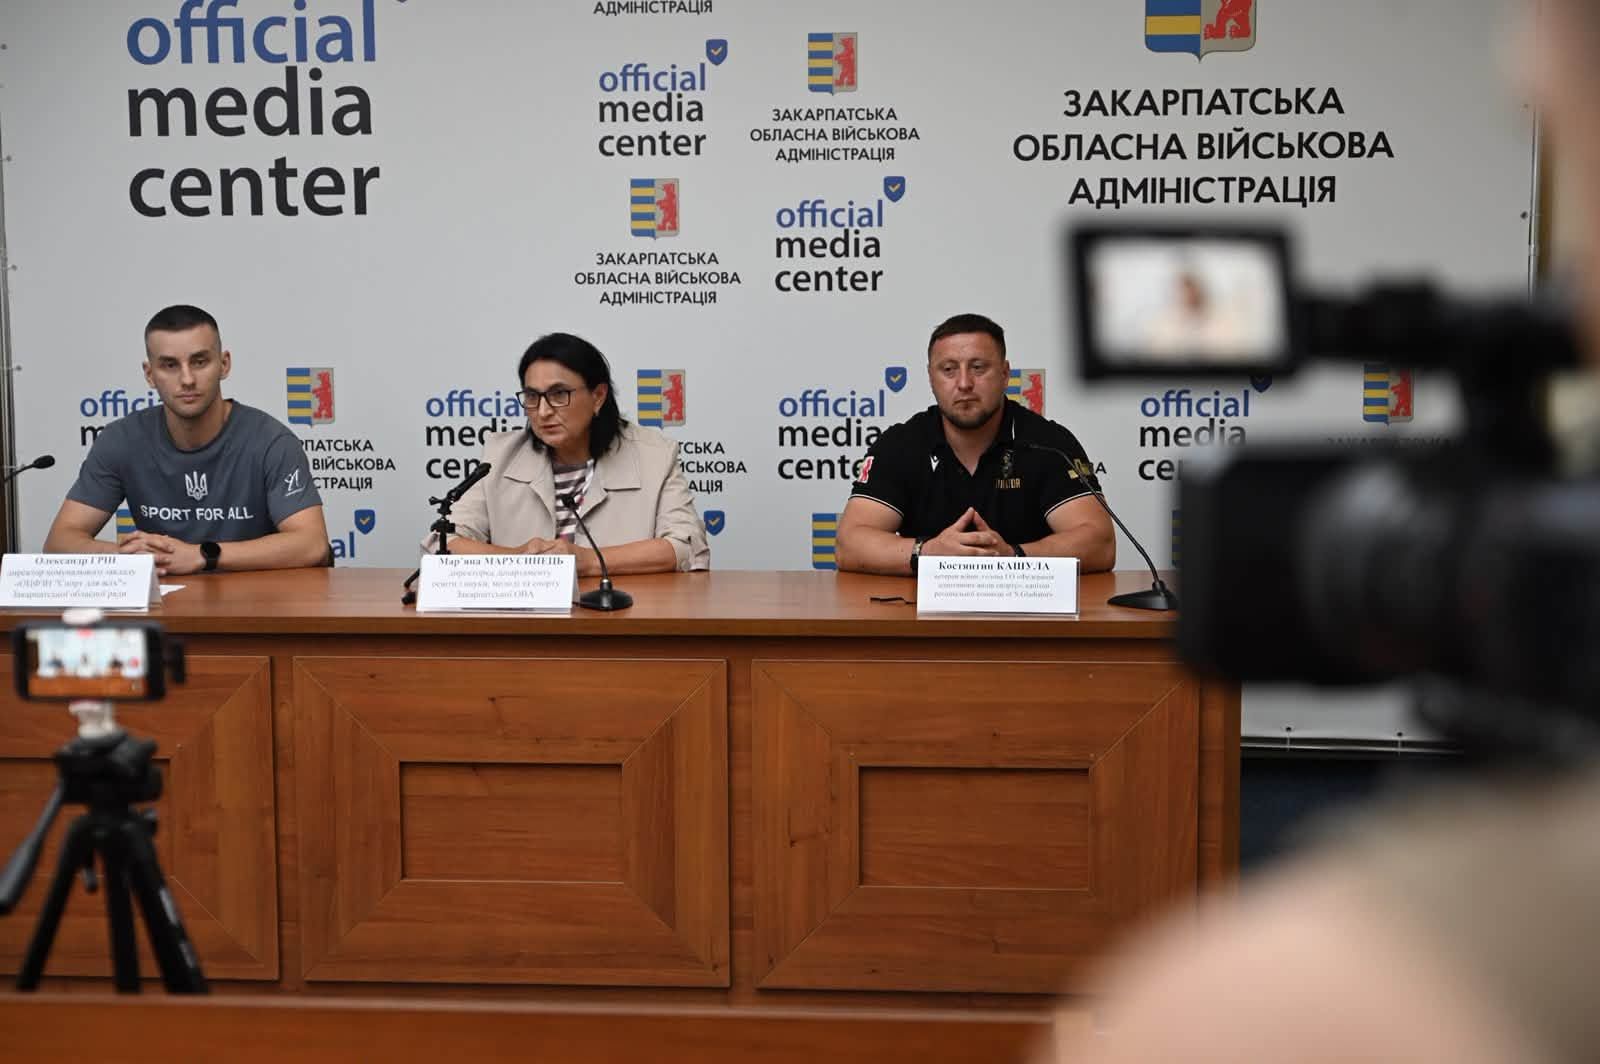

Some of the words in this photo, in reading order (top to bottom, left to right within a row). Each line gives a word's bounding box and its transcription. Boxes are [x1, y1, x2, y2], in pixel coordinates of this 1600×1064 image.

[593, 0, 712, 16] АДМІНІСТРАЦІЯ
[127, 0, 376, 65] official
[599, 63, 706, 92] official
[128, 66, 372, 137] media
[599, 93, 704, 122] media
[772, 108, 897, 121] ЗАКАРПАТСЬКА
[1064, 87, 1344, 117] ЗАКАРПАТСЬКА
[599, 131, 706, 156] center
[750, 128, 828, 142] ОБЛАСНА
[832, 126, 920, 140] ВІЙСЬКОВА
[1014, 133, 1187, 161] ОБЛАСНА
[1198, 127, 1394, 159] ВІЙСЬКОВА
[775, 147, 895, 163] АДМІНІСТРАЦІЯ
[129, 157, 380, 217] center
[1068, 176, 1337, 209] АДМІНІСТРАЦІЯ
[776, 199, 883, 228] official
[776, 229, 881, 258] media
[596, 252, 719, 265] ЗАКАРПАТСЬКА
[575, 272, 650, 285] ОБЛАСНА
[655, 270, 741, 284] ВІЙСЬКОВА
[775, 266, 883, 292] center
[600, 291, 717, 306] АДМІНІСТРАЦІЯ
[80, 390, 164, 417] offici
[779, 390, 885, 417] official
[1141, 390, 1249, 417] official
[779, 418, 882, 446] media
[1140, 418, 1246, 447] media
[301, 440, 374, 452] ПАТСЬКА
[312, 456, 396, 471] ВІЙСЬКОВА
[140, 505, 191, 521] SPORT
[196, 508, 225, 521] FOR
[228, 506, 254, 520] ALL
